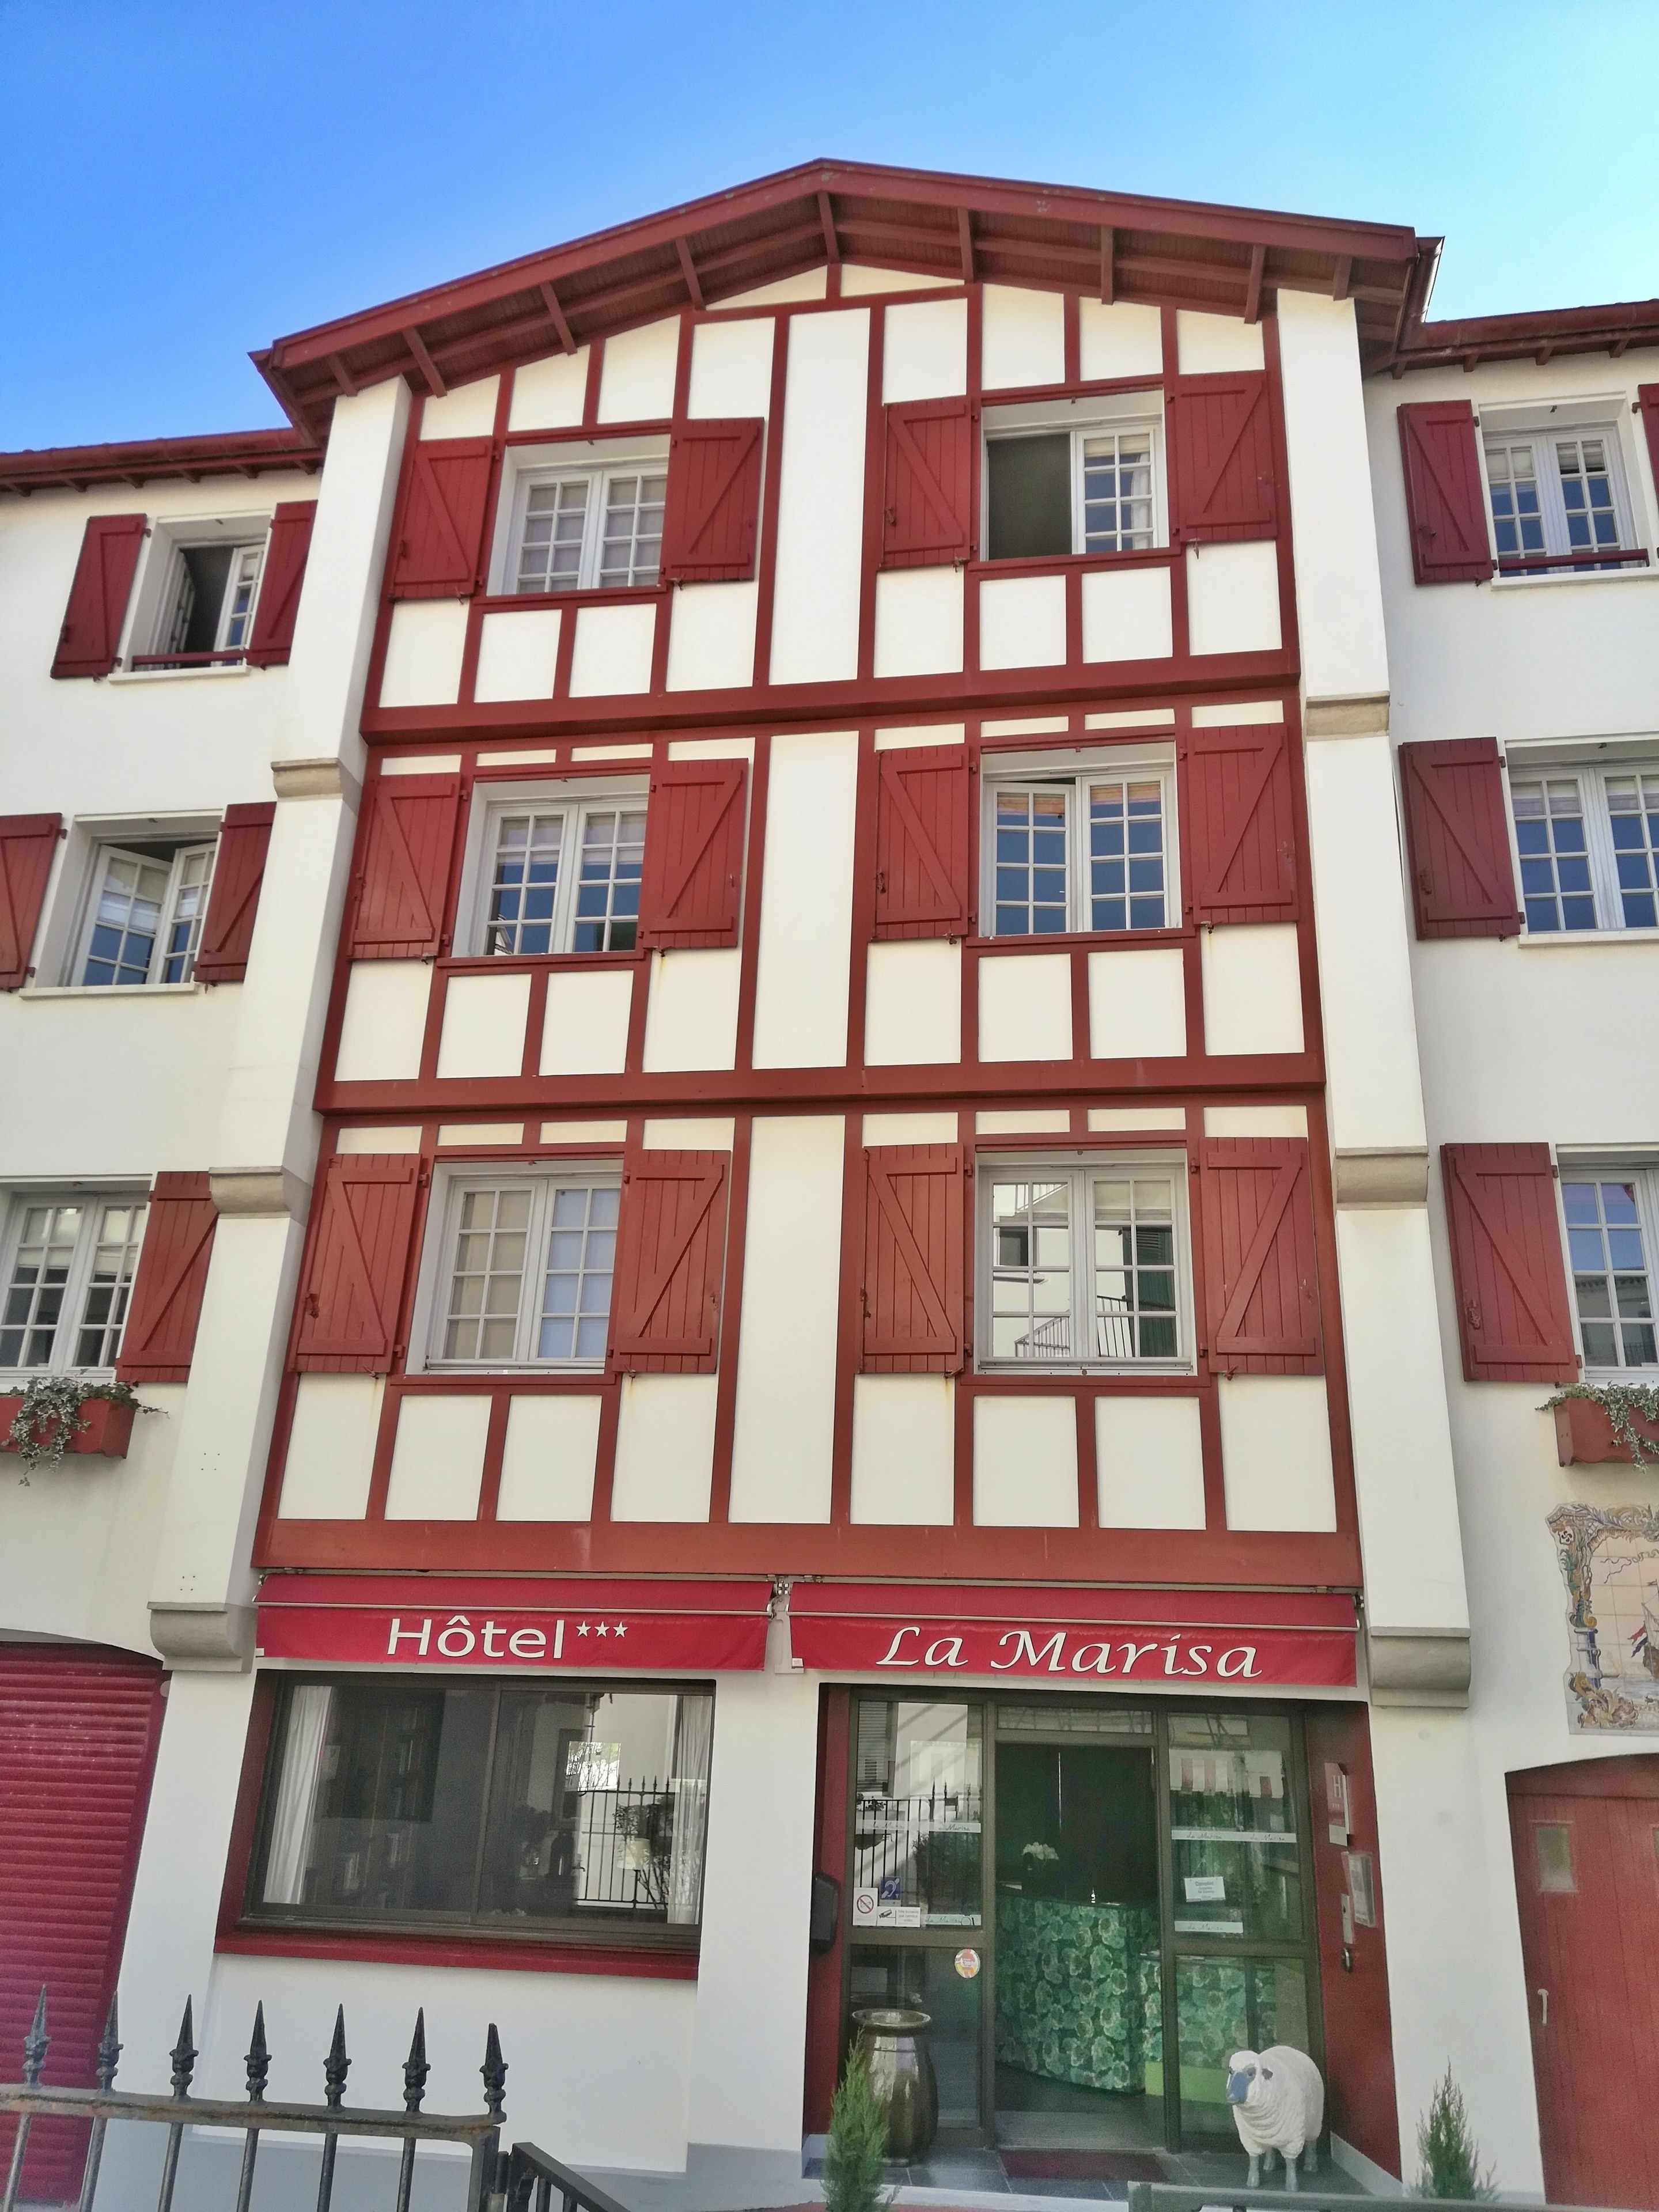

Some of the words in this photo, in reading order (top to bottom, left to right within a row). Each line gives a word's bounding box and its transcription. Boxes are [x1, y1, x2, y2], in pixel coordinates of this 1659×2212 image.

[387, 1615, 565, 1660] Hôtel
[876, 1626, 969, 1667] La
[990, 1630, 1263, 1678] Marisa
